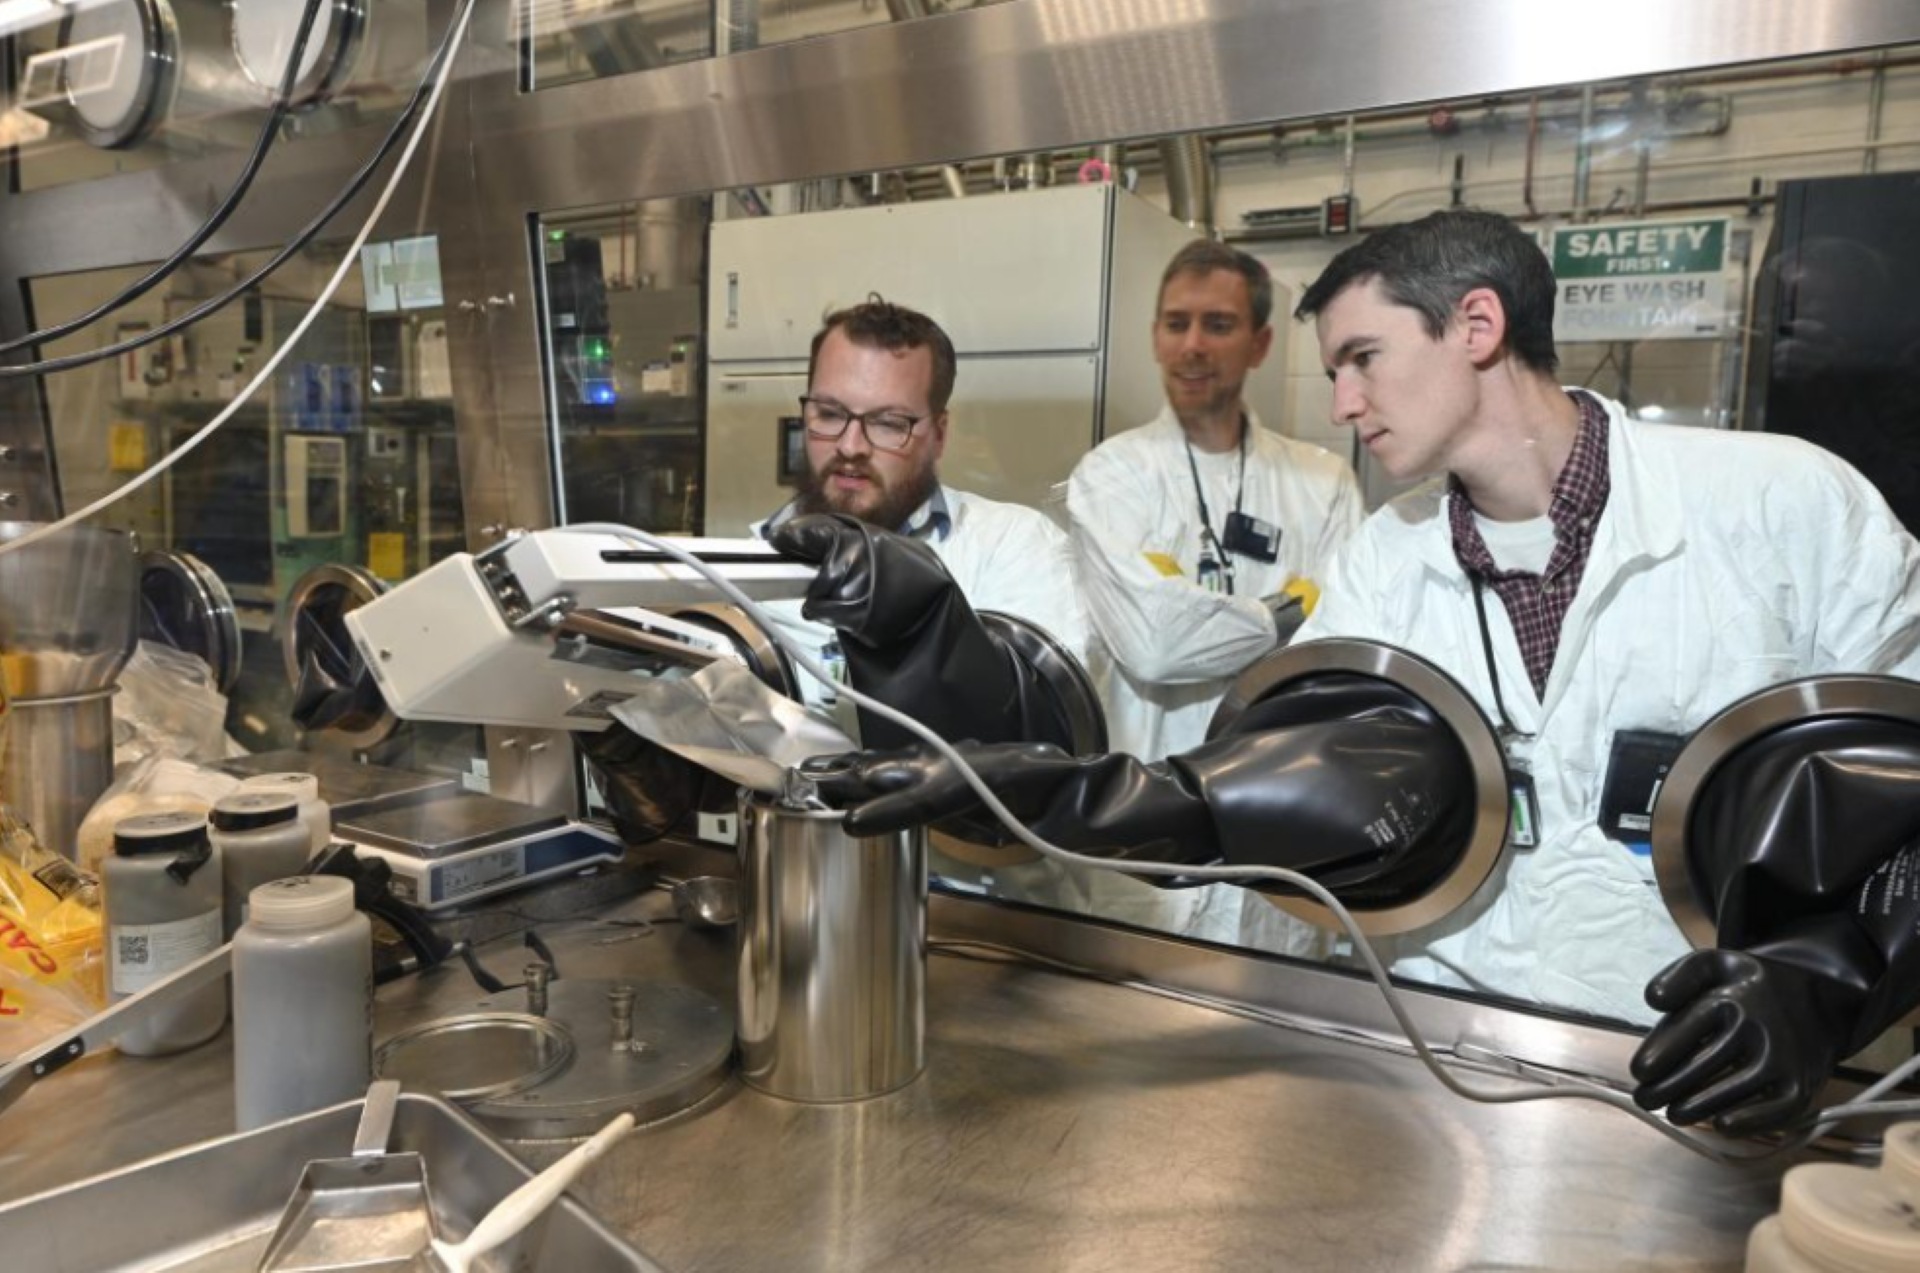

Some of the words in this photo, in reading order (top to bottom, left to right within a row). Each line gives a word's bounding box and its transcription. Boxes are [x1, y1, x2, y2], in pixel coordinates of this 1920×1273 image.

[1567, 225, 1712, 258] SAFETY
[1606, 257, 1664, 273] FIRST
[1565, 284, 1617, 304] EYE
[1624, 280, 1706, 303] WASH
[1562, 305, 1698, 330] FOTAIN
